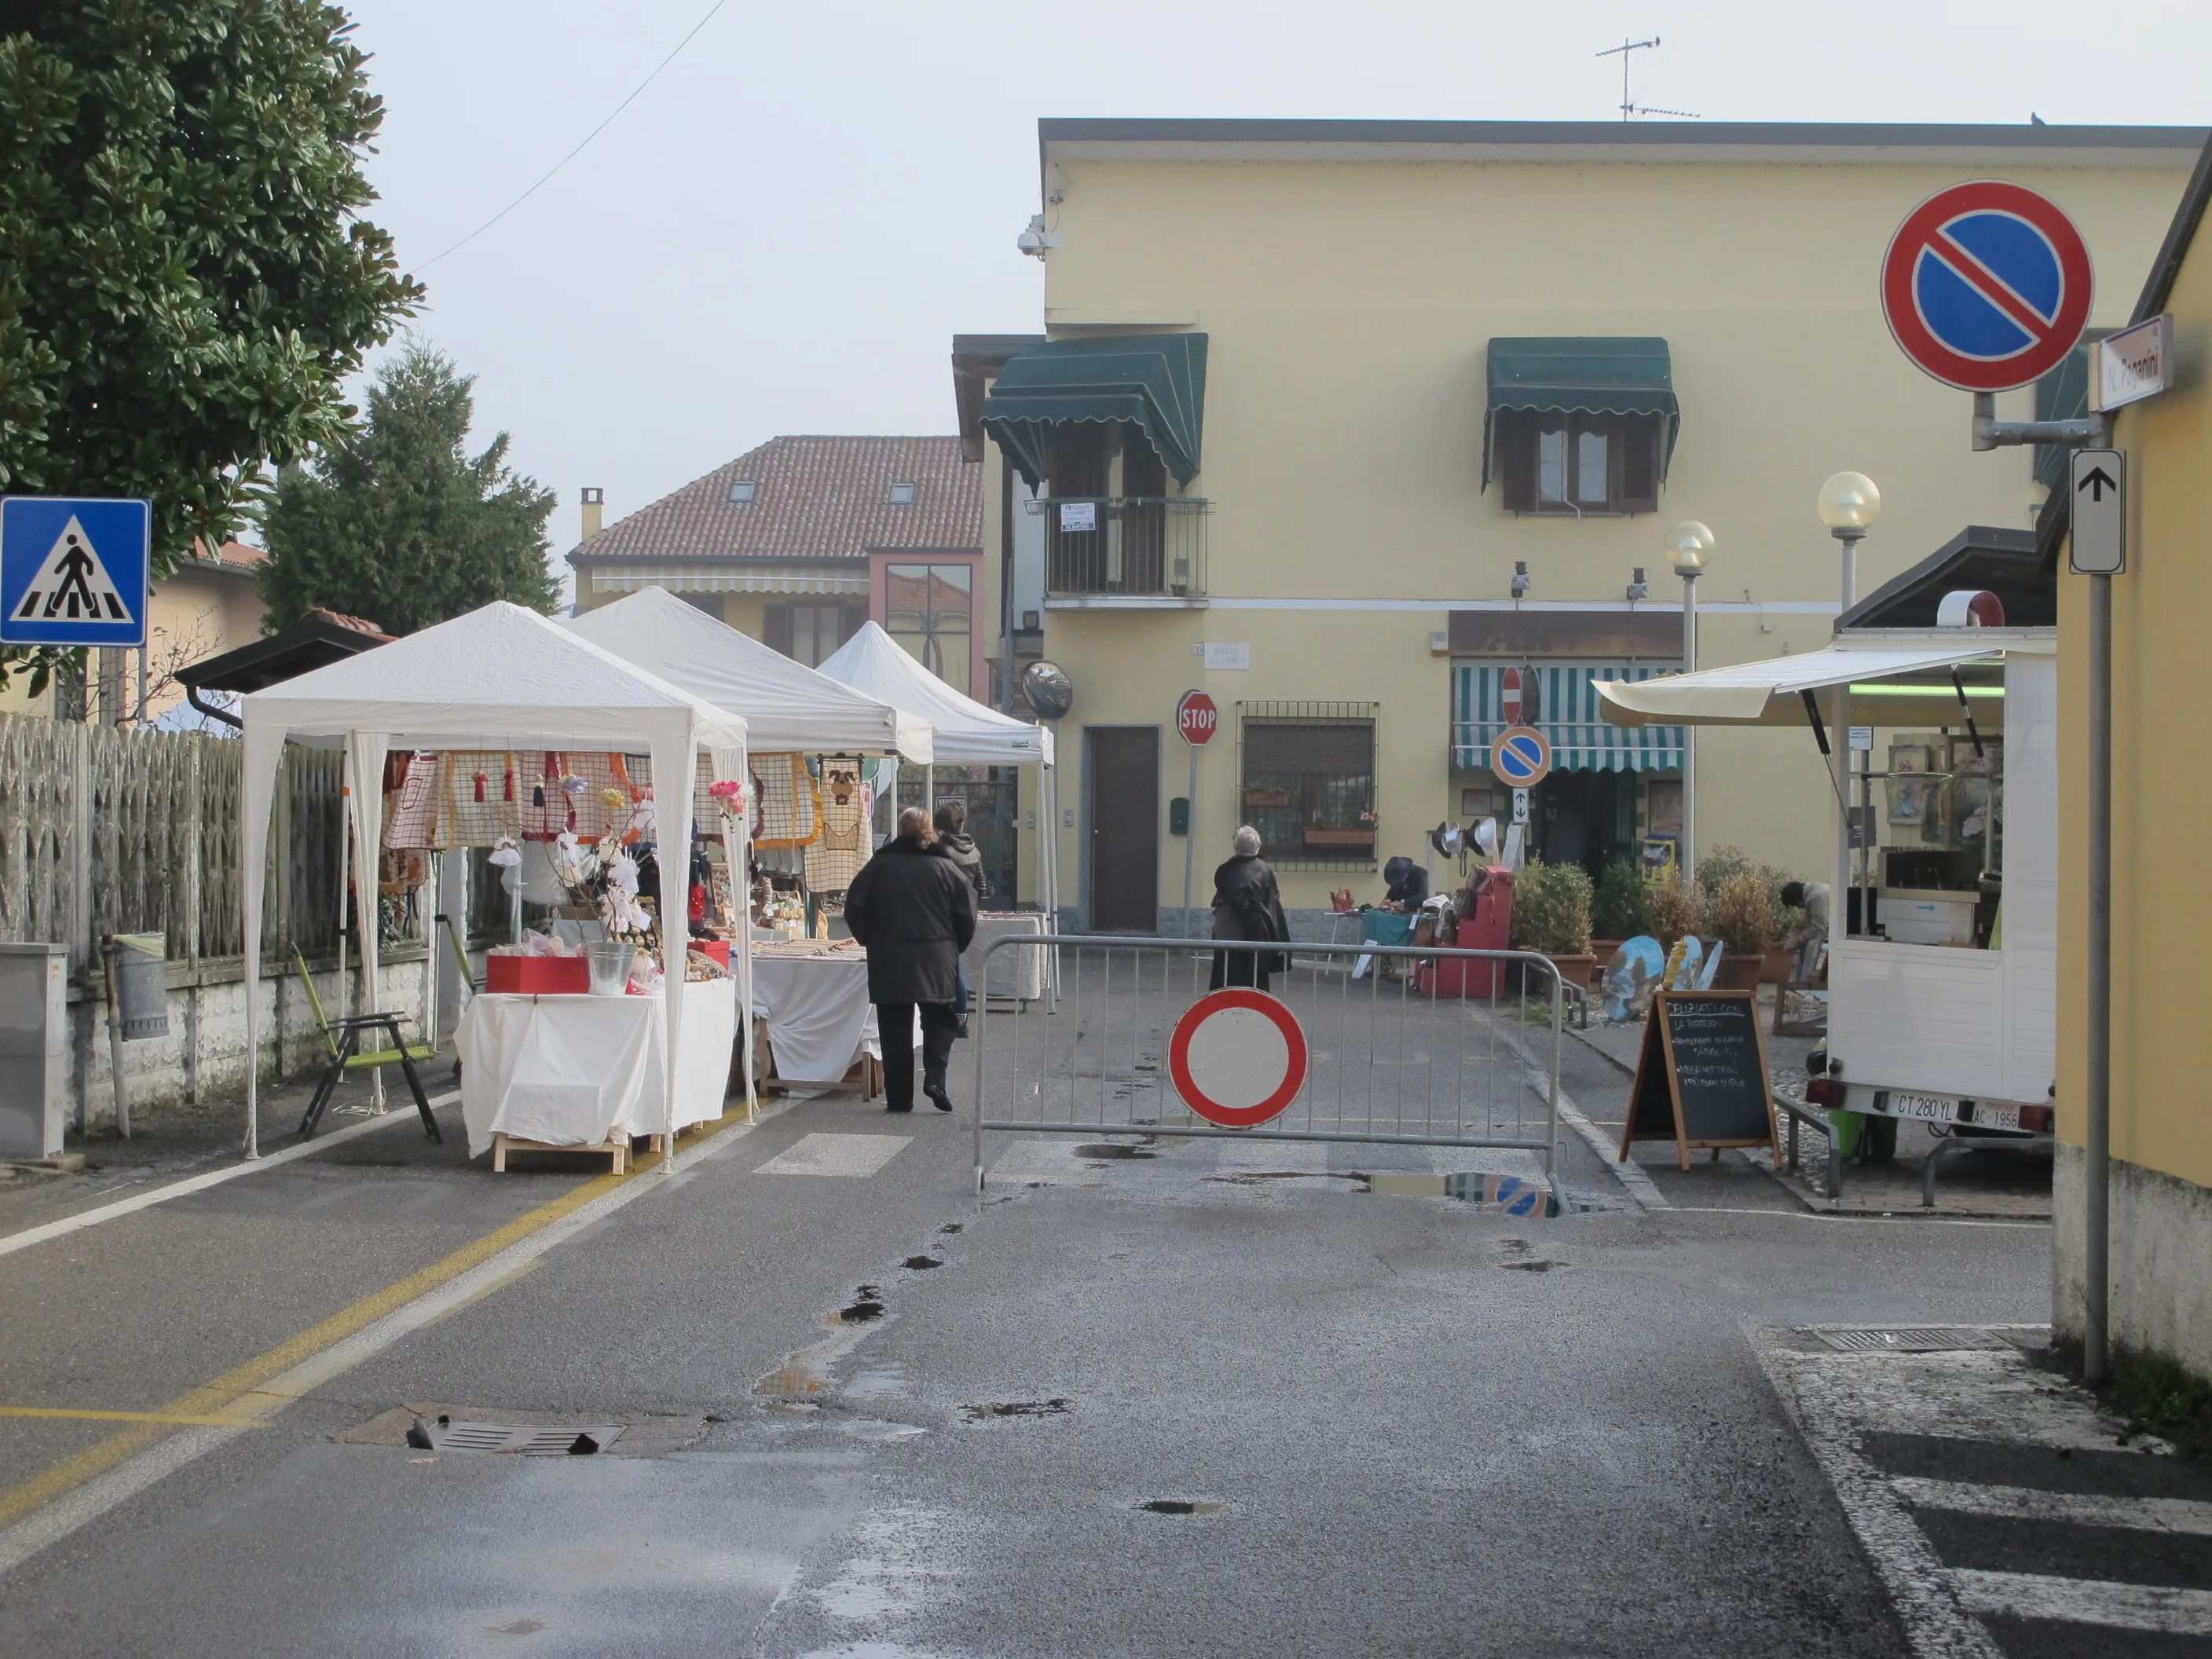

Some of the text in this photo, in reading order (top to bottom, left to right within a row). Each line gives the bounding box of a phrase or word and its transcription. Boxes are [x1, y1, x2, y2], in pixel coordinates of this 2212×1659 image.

[2122, 344, 2159, 390] Paganini
[1181, 709, 1215, 729] STOP
[1667, 1002, 1716, 1014] DELIZIATI
[1898, 1095, 1914, 1115] CT
[1915, 1097, 1938, 1117] 280
[1940, 1101, 1952, 1121] YL
[1994, 1111, 2018, 1128] 1956
